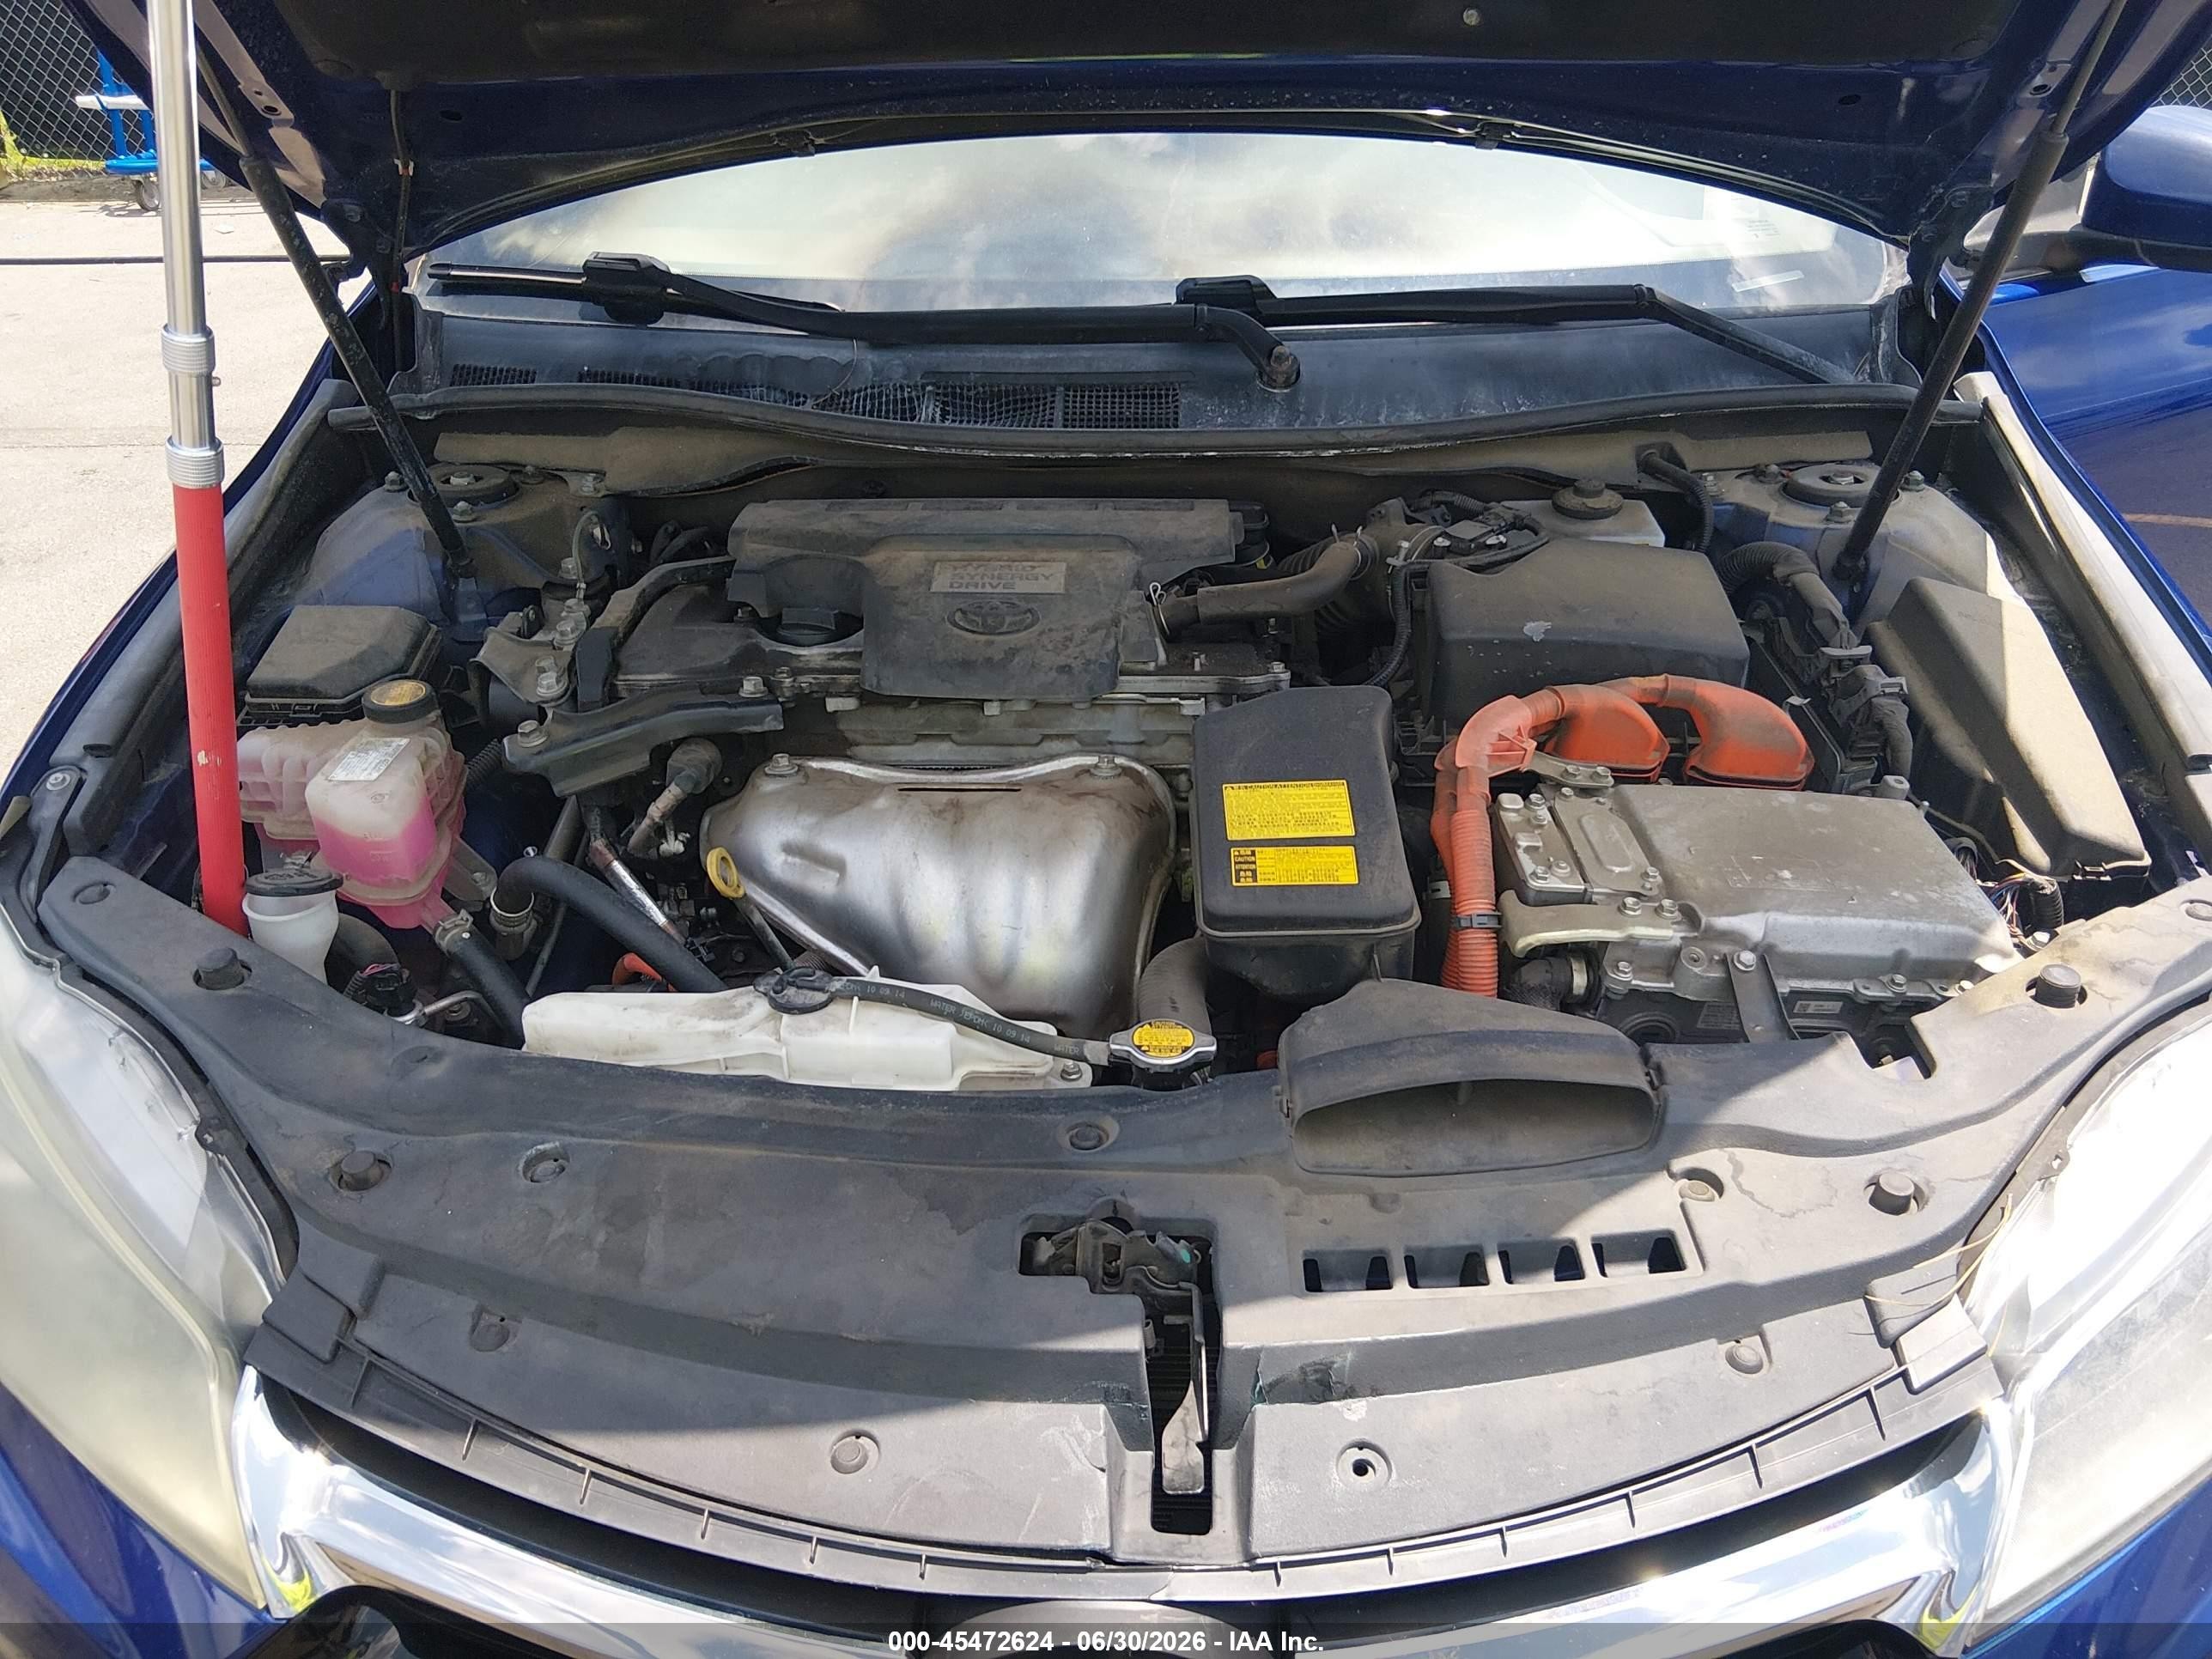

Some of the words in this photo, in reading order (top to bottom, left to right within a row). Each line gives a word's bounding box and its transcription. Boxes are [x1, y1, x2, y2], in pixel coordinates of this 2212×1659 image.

[950, 572, 1054, 581] SYNERGY
[949, 580, 1017, 591] DRIVE
[930, 998, 957, 1014] WATER
[992, 1023, 1003, 1032] 10
[1006, 1028, 1017, 1038] 09
[1054, 1042, 1080, 1056] WATER
